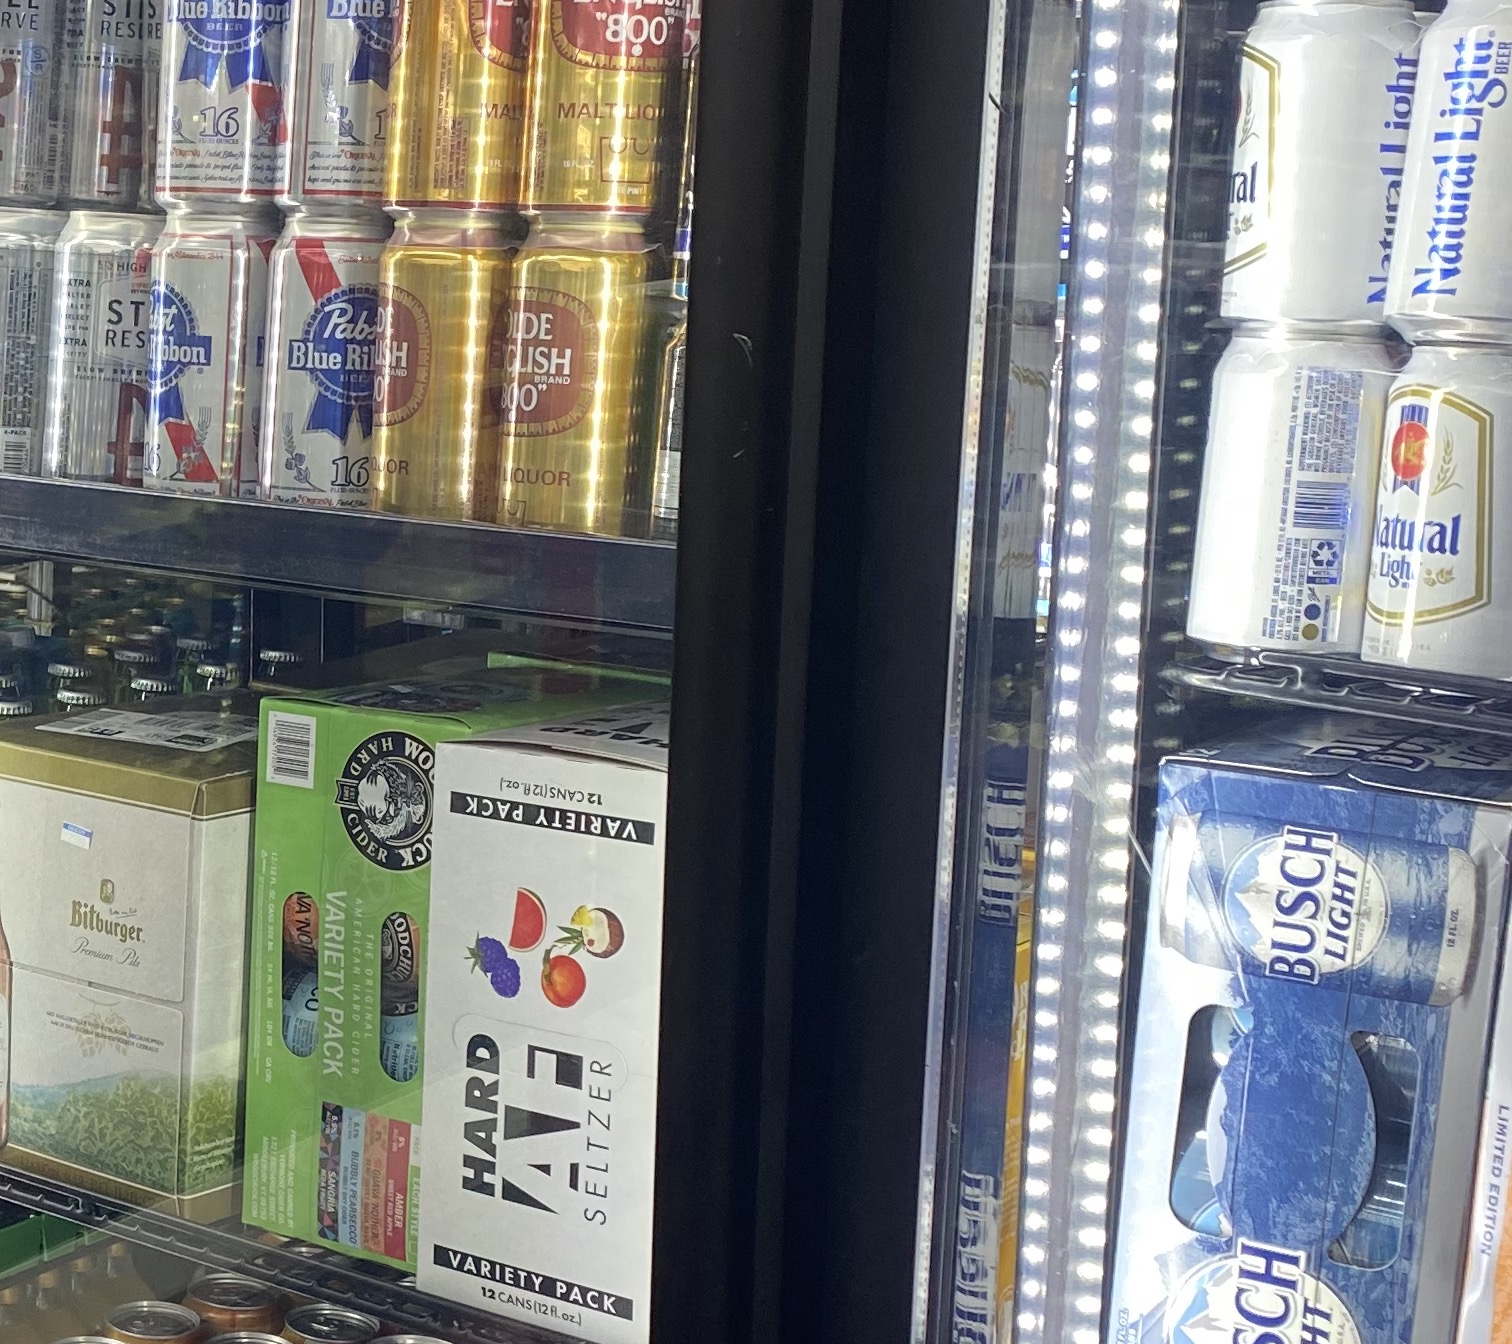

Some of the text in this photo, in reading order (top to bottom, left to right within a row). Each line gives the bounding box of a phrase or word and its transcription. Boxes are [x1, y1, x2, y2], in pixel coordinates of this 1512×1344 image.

[206, 22, 244, 32] BEER
[199, 106, 239, 138] 16
[557, 103, 616, 120] MALT
[1411, 36, 1509, 298] Natural Light
[117, 261, 147, 273] HIGH
[290, 341, 342, 370] Blue
[534, 375, 571, 385] BRAND
[331, 455, 369, 487] 16
[349, 736, 394, 777] HARD
[464, 794, 639, 842] VARIETY PACK
[549, 787, 603, 806] 12 CANS
[347, 813, 388, 863] CIDER
[69, 899, 145, 944] Bitburger
[1266, 824, 1337, 985] BUSCH
[1324, 862, 1358, 962] LIGHT
[71, 936, 141, 968] Premium Pils
[322, 890, 348, 1078] VARIETY PACK
[351, 896, 364, 1076] AMERICAN HARD CIDER
[364, 933, 375, 1040] THE ORIGINAL
[462, 1033, 501, 1197] HARD
[583, 1058, 614, 1226] SELTZER
[326, 1169, 338, 1214] SANGRIA
[1478, 1102, 1510, 1258] LIMITED EDITION
[348, 1190, 360, 1246] PEARSECCO
[394, 1192, 405, 1229] AMBER
[447, 1249, 618, 1314] VARIETY PACK
[481, 1286, 532, 1312] 12 CANS
